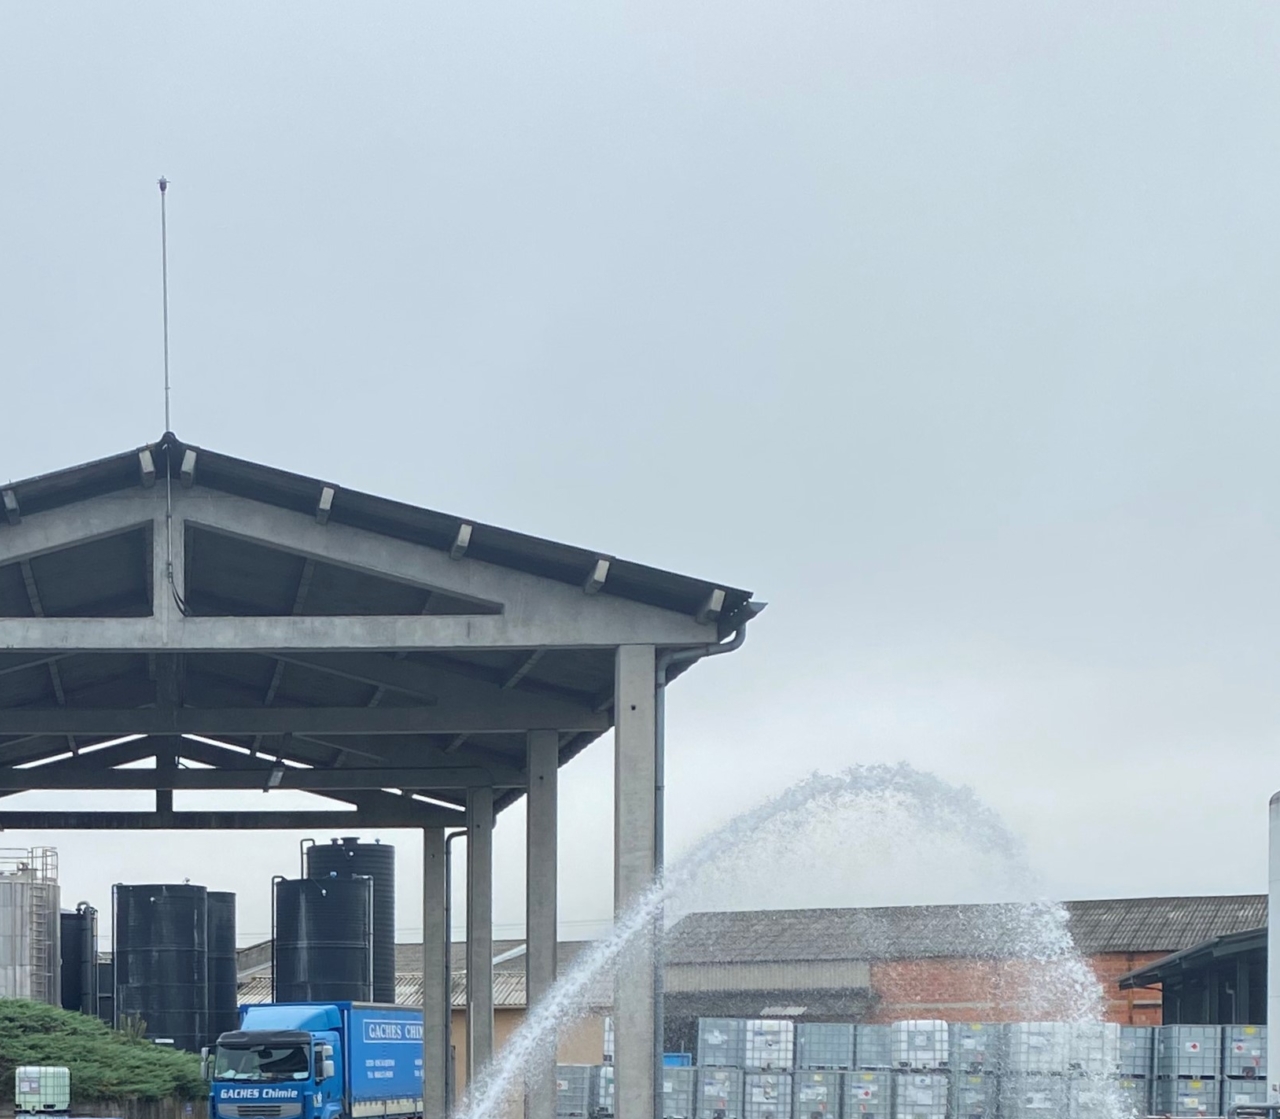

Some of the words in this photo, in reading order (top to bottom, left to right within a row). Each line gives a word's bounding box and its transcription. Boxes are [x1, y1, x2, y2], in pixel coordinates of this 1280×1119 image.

[368, 1024, 402, 1039] GACHES
[220, 1088, 260, 1099] GACHES
[262, 1088, 299, 1099] Chimie
